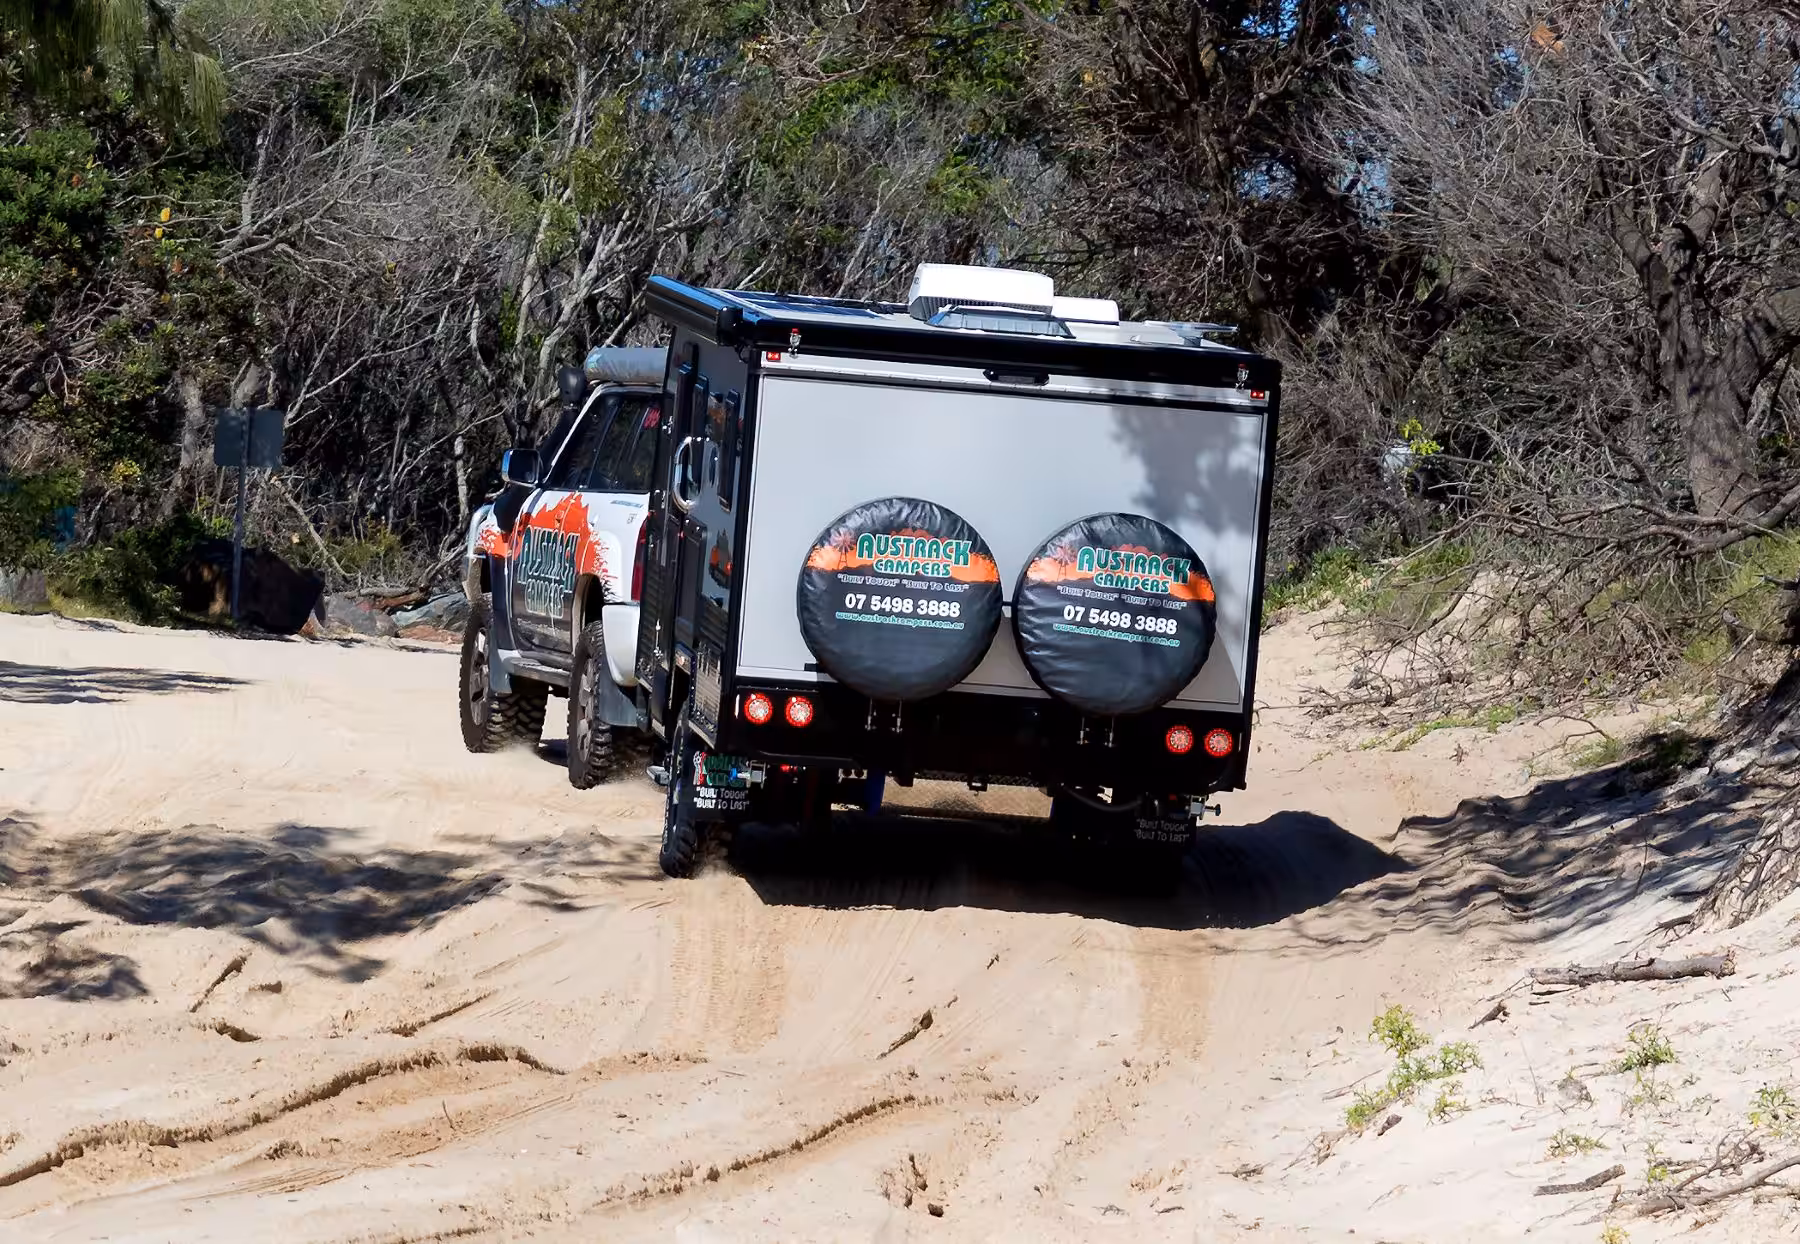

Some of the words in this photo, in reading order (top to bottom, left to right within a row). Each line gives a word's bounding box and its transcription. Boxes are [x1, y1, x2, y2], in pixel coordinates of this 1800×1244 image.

[517, 525, 580, 593] AUSTRACK
[856, 533, 972, 567] AUSTRACK
[873, 558, 952, 578] CAMPERS
[1076, 546, 1192, 585] AUSTRACK
[1093, 572, 1171, 595] CAMPERS
[845, 593, 866, 609] 07
[870, 595, 914, 613] 5498
[917, 599, 961, 618] 3888
[835, 611, 965, 630] www.austrackcampers.com.au
[1063, 605, 1086, 622] 07
[1088, 608, 1131, 629] 5498
[1134, 615, 1178, 635] 3888
[1053, 622, 1180, 648] www.austrackcampers.com.au
